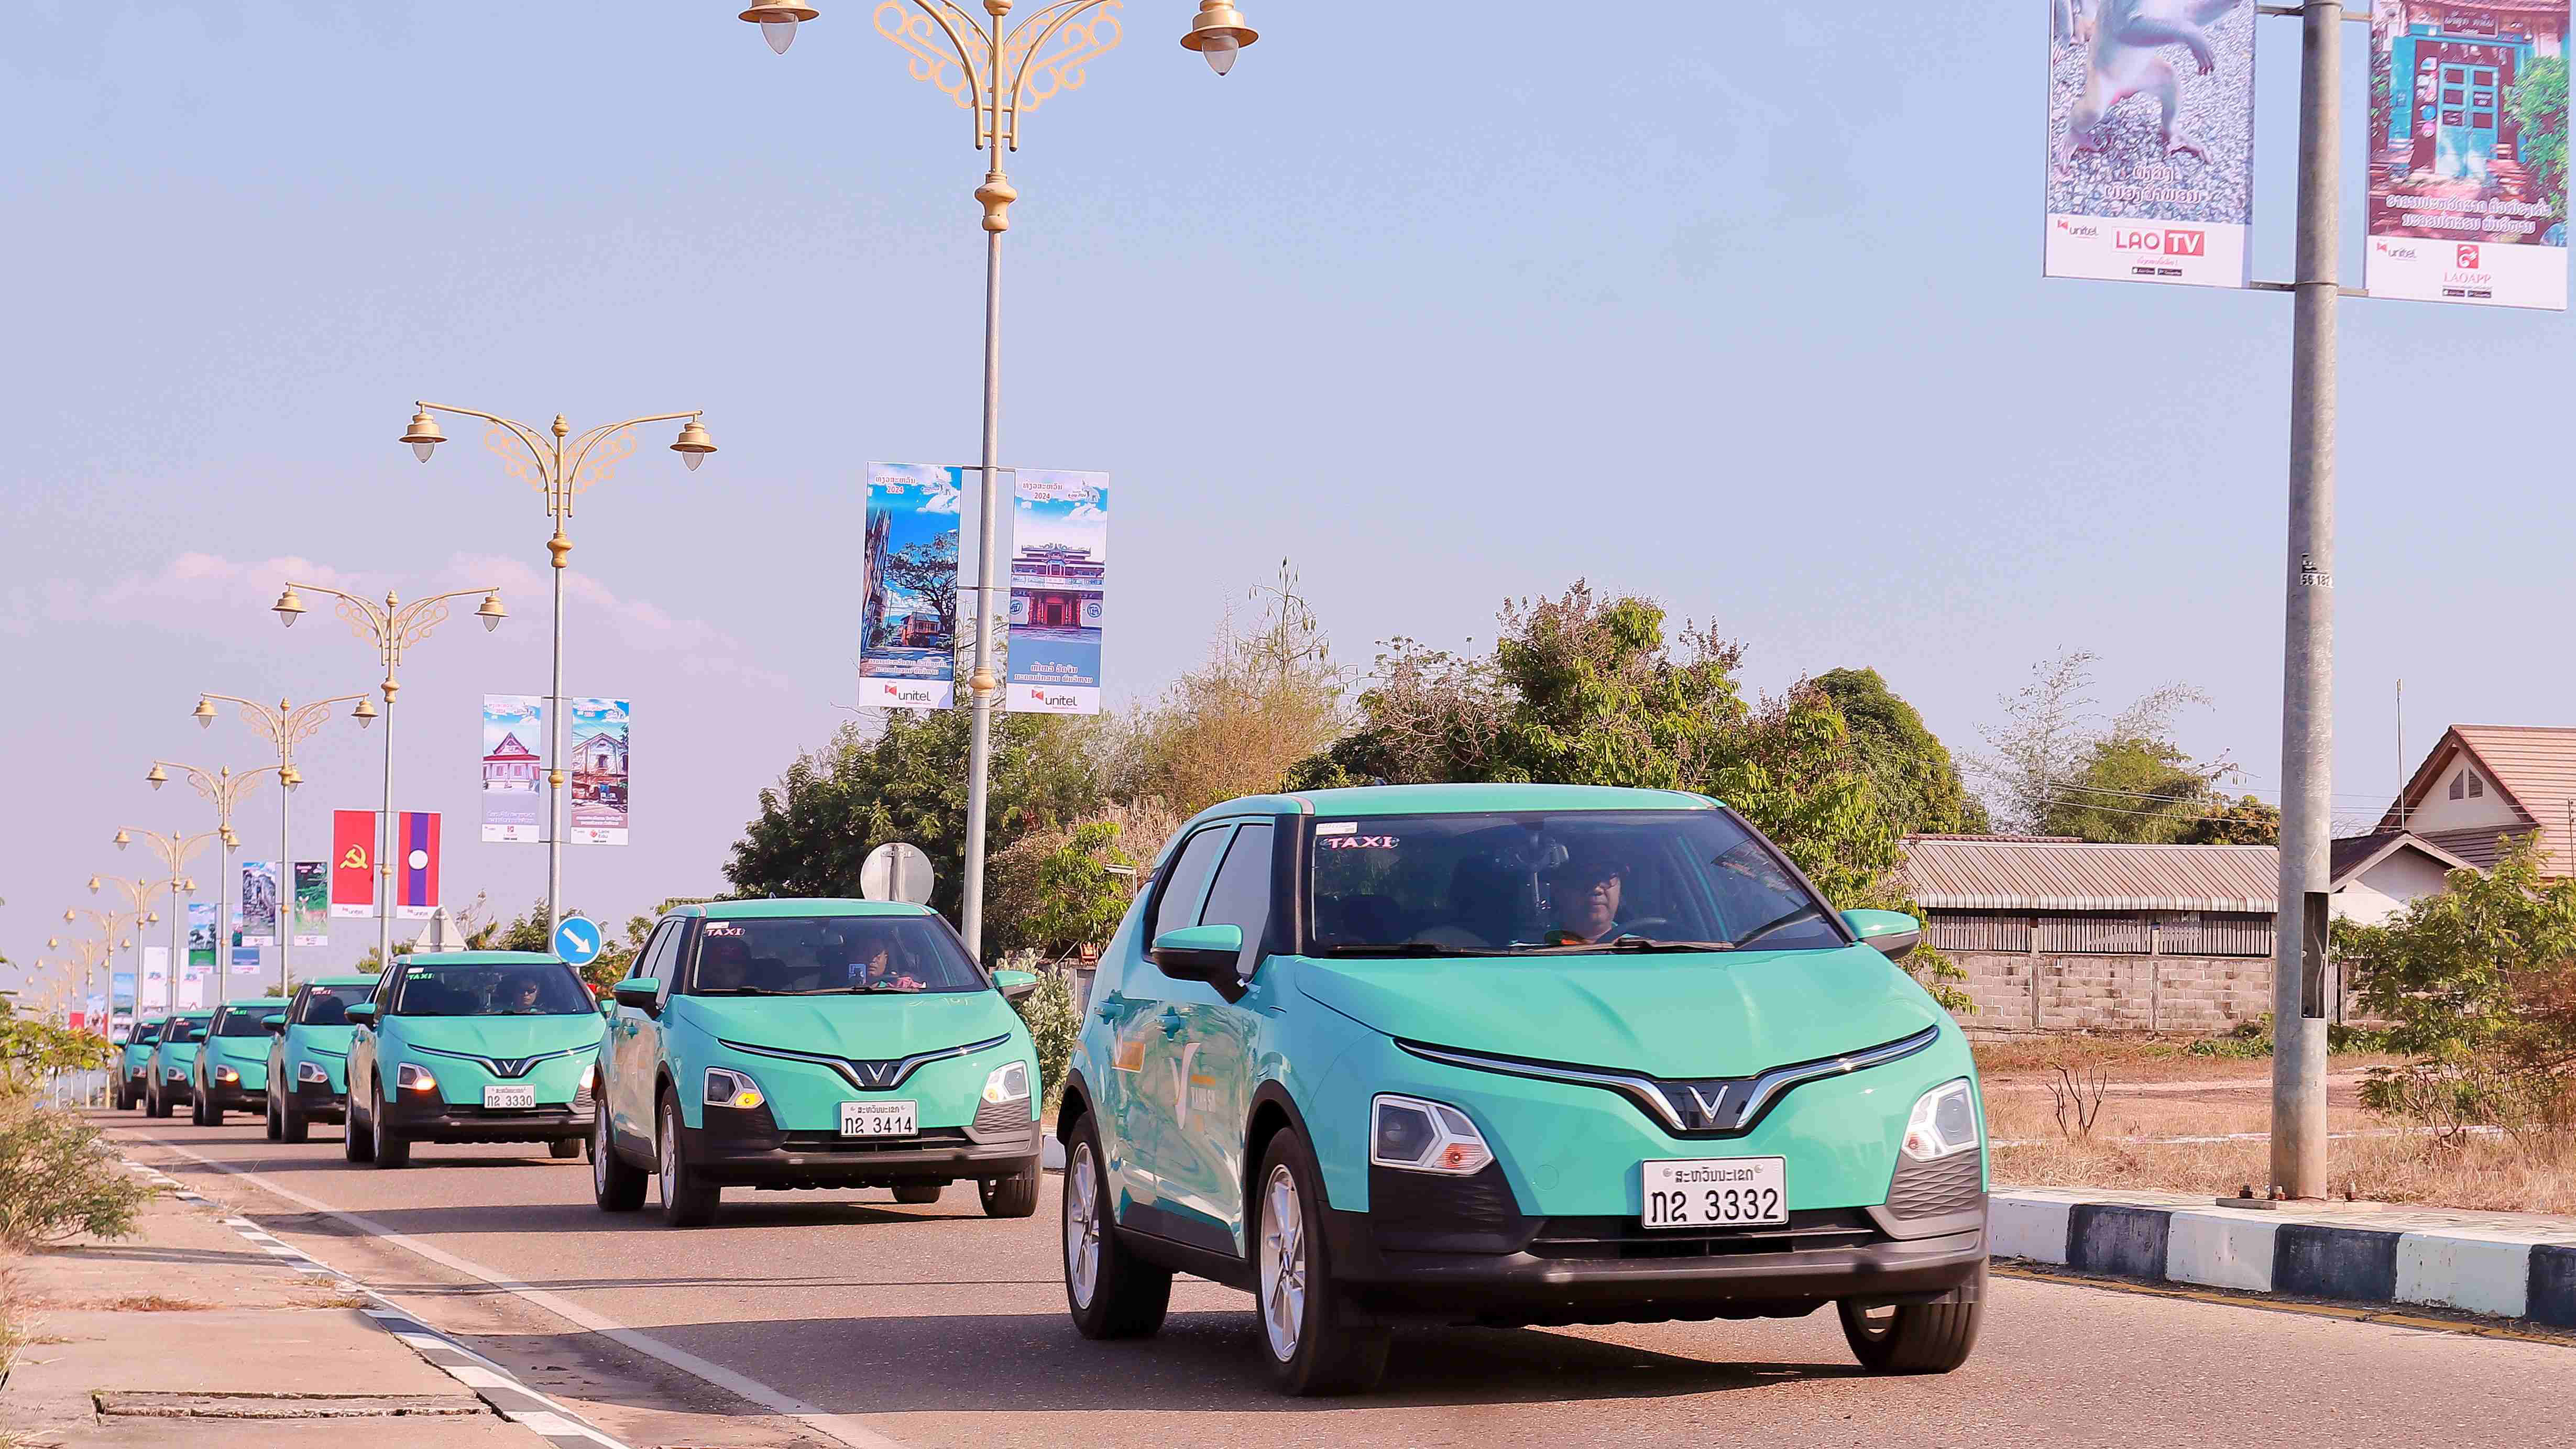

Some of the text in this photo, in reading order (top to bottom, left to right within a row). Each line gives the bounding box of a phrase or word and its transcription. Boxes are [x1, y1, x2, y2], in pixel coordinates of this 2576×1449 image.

[2116, 231, 2200, 254] LAO TV
[1034, 492, 1050, 501] 2024
[898, 690, 931, 701] unitel
[1045, 695, 1077, 706] unitel
[1327, 836, 1393, 849] TAXI
[707, 927, 742, 936] TAXI
[506, 1095, 532, 1106] 3330
[845, 1116, 913, 1134] ກຂ 3414
[1651, 1188, 1779, 1223] ກຂ 3332
